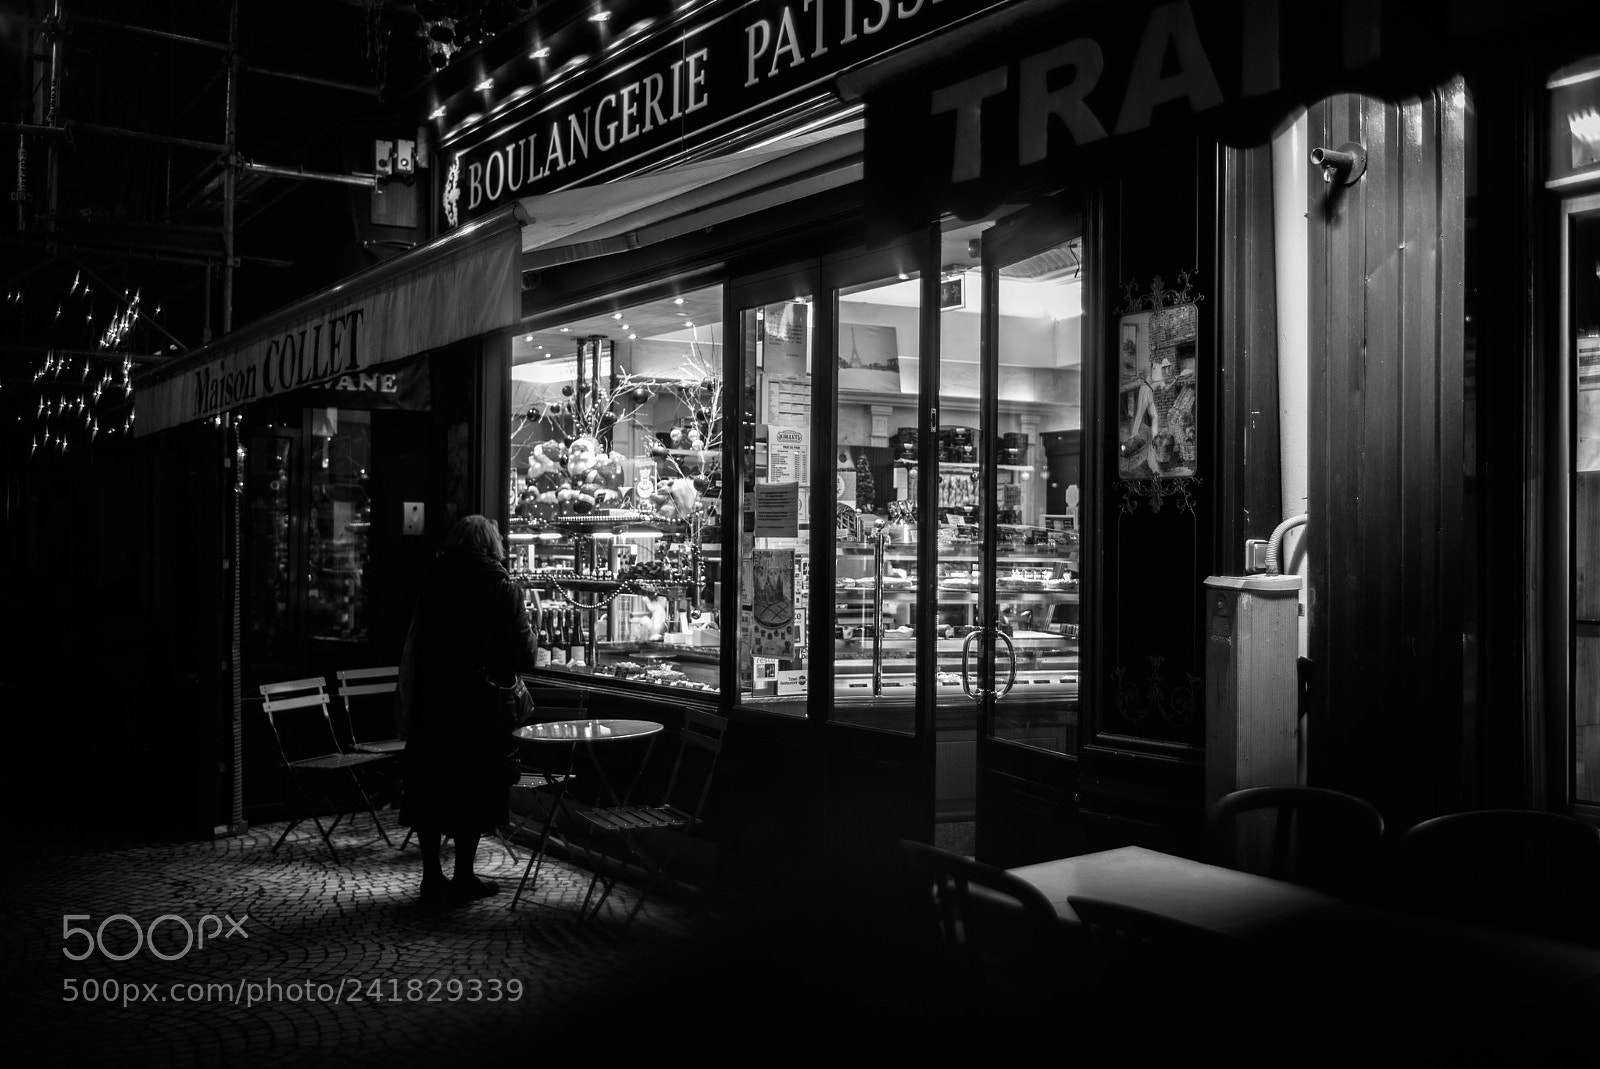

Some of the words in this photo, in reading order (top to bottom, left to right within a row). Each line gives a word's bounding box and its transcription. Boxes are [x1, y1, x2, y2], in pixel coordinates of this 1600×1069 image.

[467, 47, 710, 211] BOULANGERIE
[744, 0, 946, 89] PATIS
[193, 360, 257, 416] Maison
[263, 308, 364, 394] COLLET
